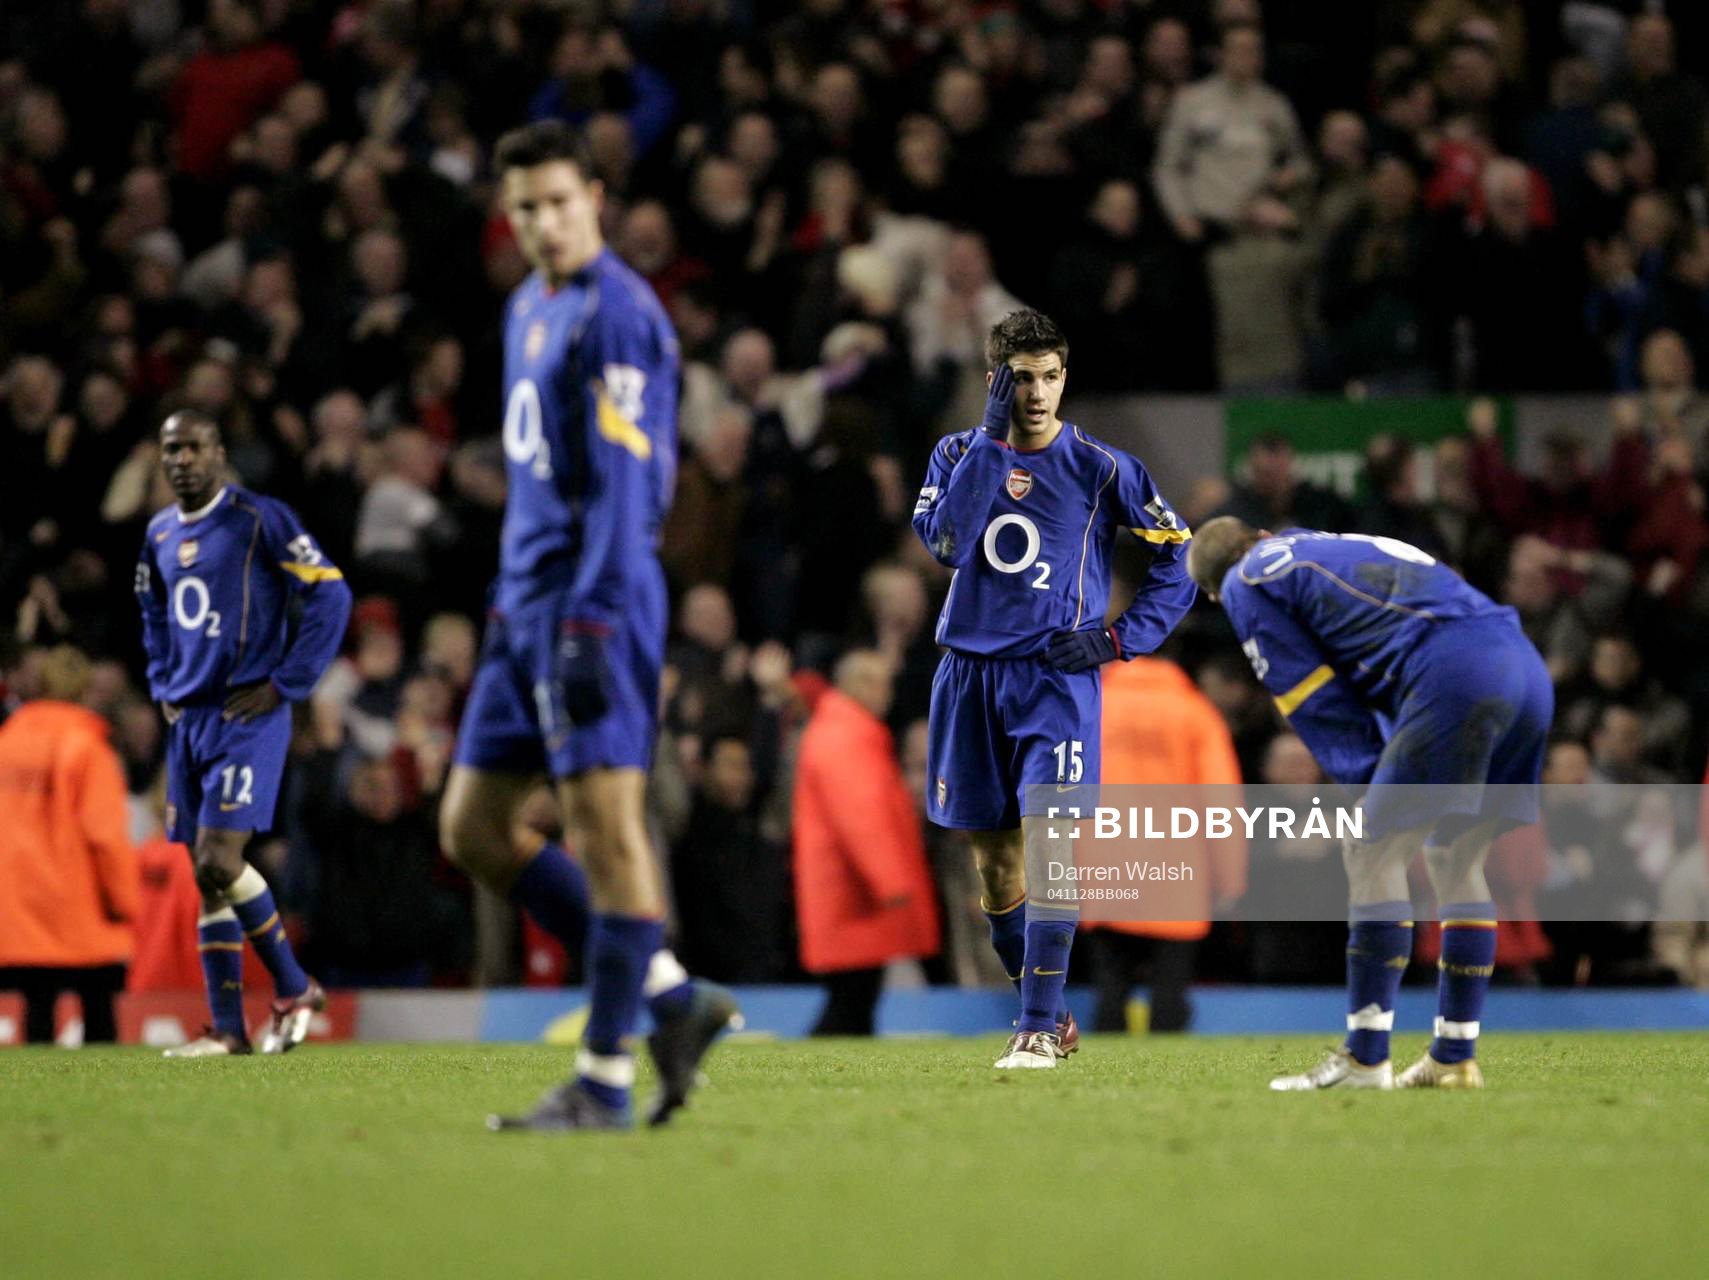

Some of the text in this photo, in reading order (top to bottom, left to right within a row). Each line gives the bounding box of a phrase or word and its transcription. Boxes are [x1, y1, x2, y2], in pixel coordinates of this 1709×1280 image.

[984, 513, 1050, 590] O2
[174, 576, 221, 637] O2
[221, 764, 254, 805] 12
[1053, 740, 1084, 783] 15
